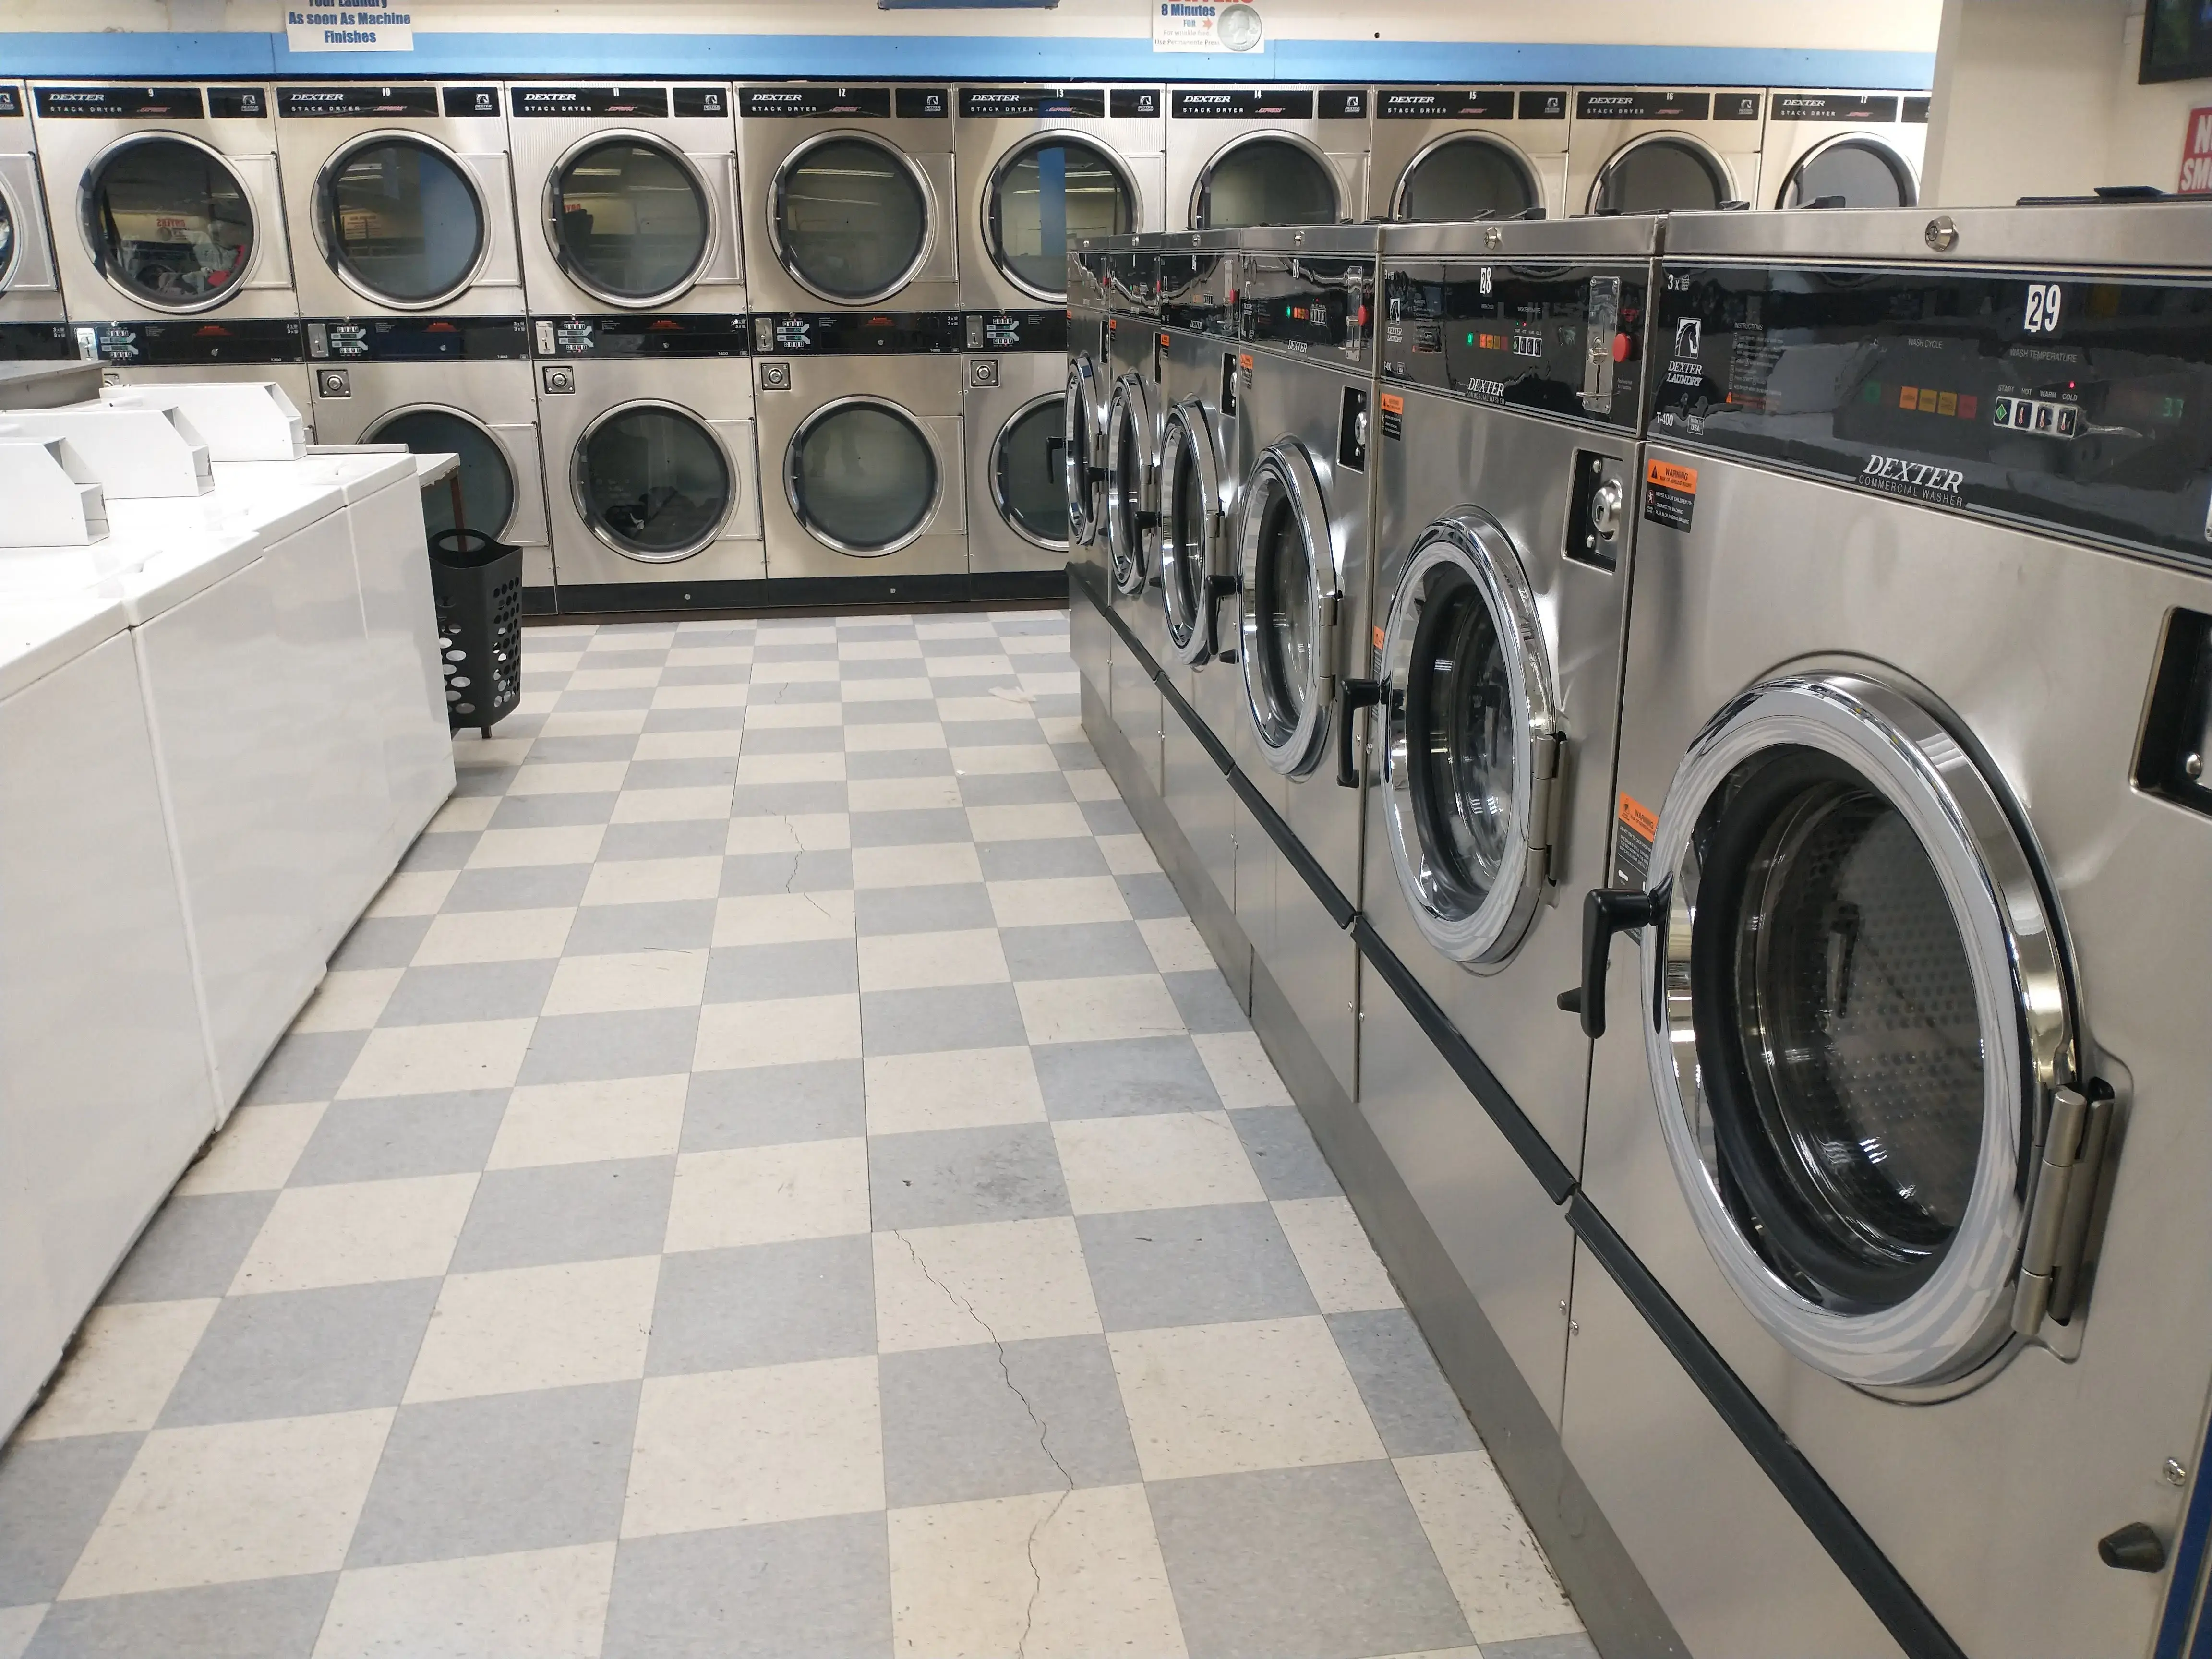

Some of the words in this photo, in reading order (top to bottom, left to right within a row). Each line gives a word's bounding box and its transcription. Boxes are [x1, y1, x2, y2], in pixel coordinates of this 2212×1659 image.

[1162, 4, 1168, 16] 8
[1171, 4, 1215, 17] Minutes
[289, 12, 304, 24] As
[307, 13, 337, 24] soon
[340, 12, 355, 25] As
[358, 12, 410, 25] Machine
[325, 30, 376, 43] Finishes
[148, 88, 153, 97] 9
[383, 88, 391, 96] 10
[839, 88, 846, 97] 12
[1056, 89, 1064, 98] 13
[1254, 90, 1262, 99] 14
[1469, 91, 1477, 100] 15
[2194, 115, 2212, 154] N
[2181, 158, 2212, 191] SM
[1480, 267, 1491, 294] 28
[1668, 274, 1674, 290] 3
[2024, 284, 2061, 332] 29
[1387, 327, 1402, 336] DEXTER
[1734, 322, 1763, 331] INSTRUCTIONS
[1288, 340, 1308, 353] DEXTER
[1908, 338, 1924, 347] WASH
[1925, 340, 1942, 349] CYCLE
[2010, 348, 2028, 357] WASH
[2030, 350, 2078, 363] TEMPERATURE
[1668, 361, 1703, 375] DEXTER
[1467, 377, 1504, 396] DEXTER
[1666, 373, 1703, 387] LAUNDRY
[1466, 391, 1489, 402] COMMERCIAL
[1489, 395, 1504, 405] WASHER
[1998, 385, 2014, 393] START
[2040, 390, 2056, 399] WARM
[2062, 393, 2078, 401] COLD
[1657, 411, 1673, 427] T-400
[1666, 468, 1688, 481] WARNING
[1863, 454, 1963, 493] DEXTER
[1859, 474, 1918, 498] COMMERCIAL
[1922, 489, 1963, 507] WASHER
[1674, 496, 1687, 505] CHILDREN
